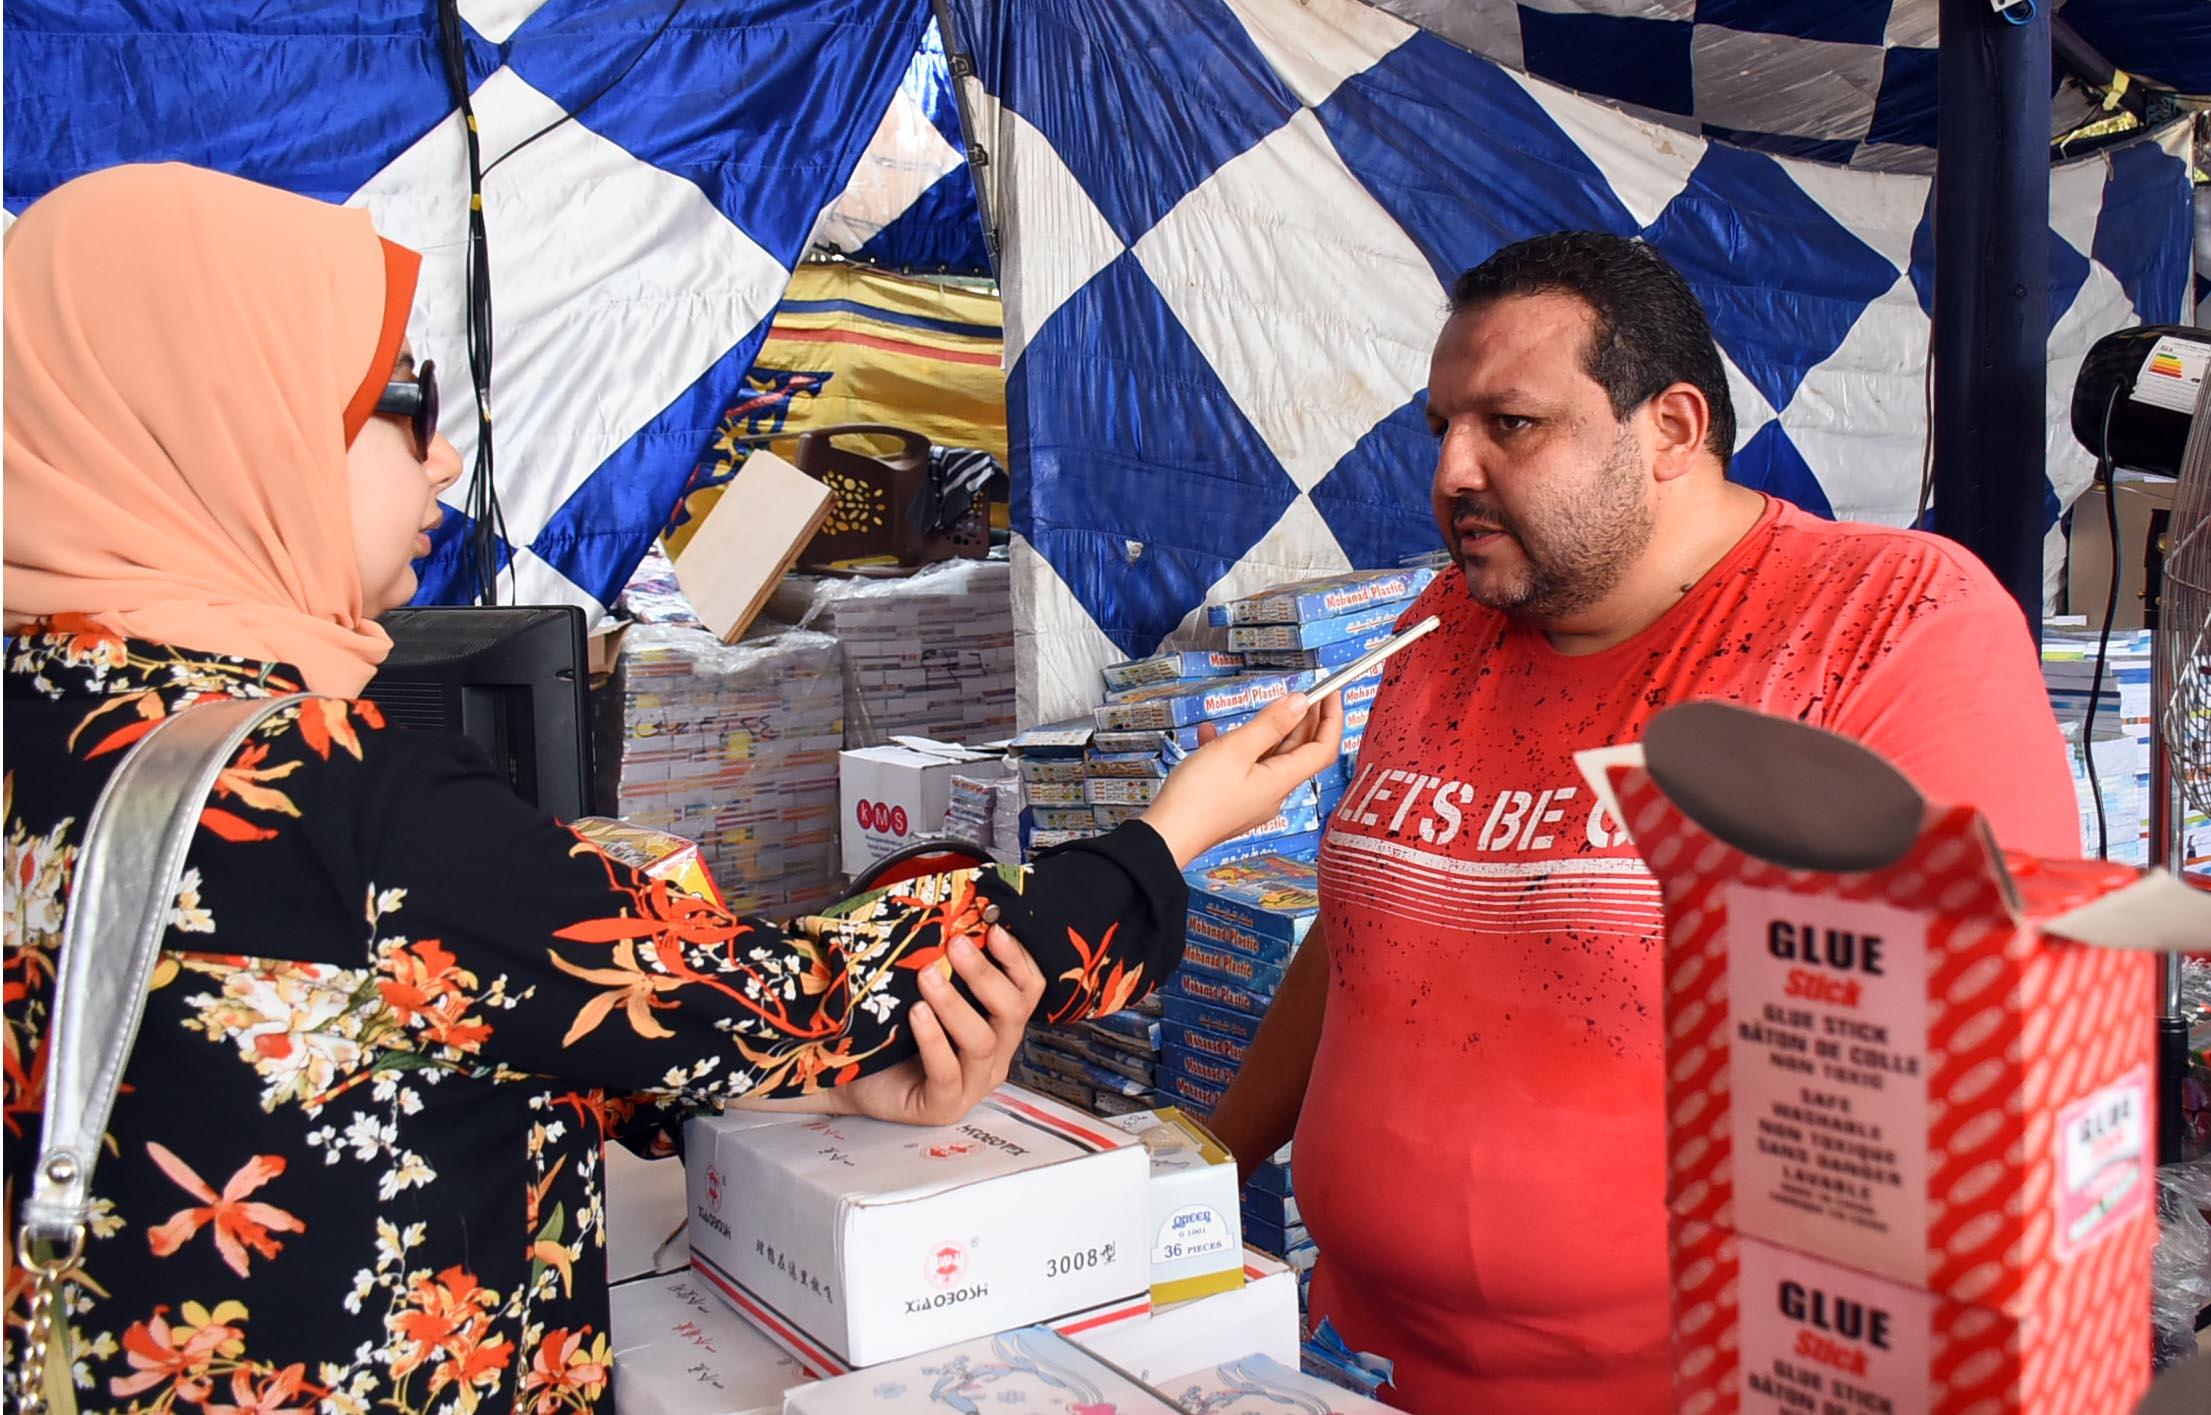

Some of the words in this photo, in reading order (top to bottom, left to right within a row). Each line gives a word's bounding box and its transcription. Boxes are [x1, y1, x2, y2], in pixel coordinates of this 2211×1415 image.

[1326, 586, 1369, 609] Mohanad
[1371, 581, 1405, 599] Plastic
[1206, 687, 1250, 711] Mohanad
[1252, 683, 1286, 701] Plastic
[859, 801, 906, 834] KMS
[1477, 787, 1577, 851] BE
[1188, 916, 1227, 940] Mohanad
[1229, 928, 1259, 953] Plastic
[1767, 919, 1884, 976] GLUE
[1184, 943, 1220, 968] Mohanad
[1223, 955, 1253, 978] Plastic
[1183, 975, 1218, 998] Mohanad
[1221, 985, 1250, 1009] Plastic
[1785, 966, 1862, 1008] Stick
[1184, 1030, 1223, 1054] Mohanad
[1823, 1015, 1888, 1045] STICK
[1163, 1243, 1183, 1259] 36
[1187, 1241, 1223, 1255] PIECES
[1778, 1279, 1891, 1351] GLUE
[1795, 1329, 1869, 1378] Stick
